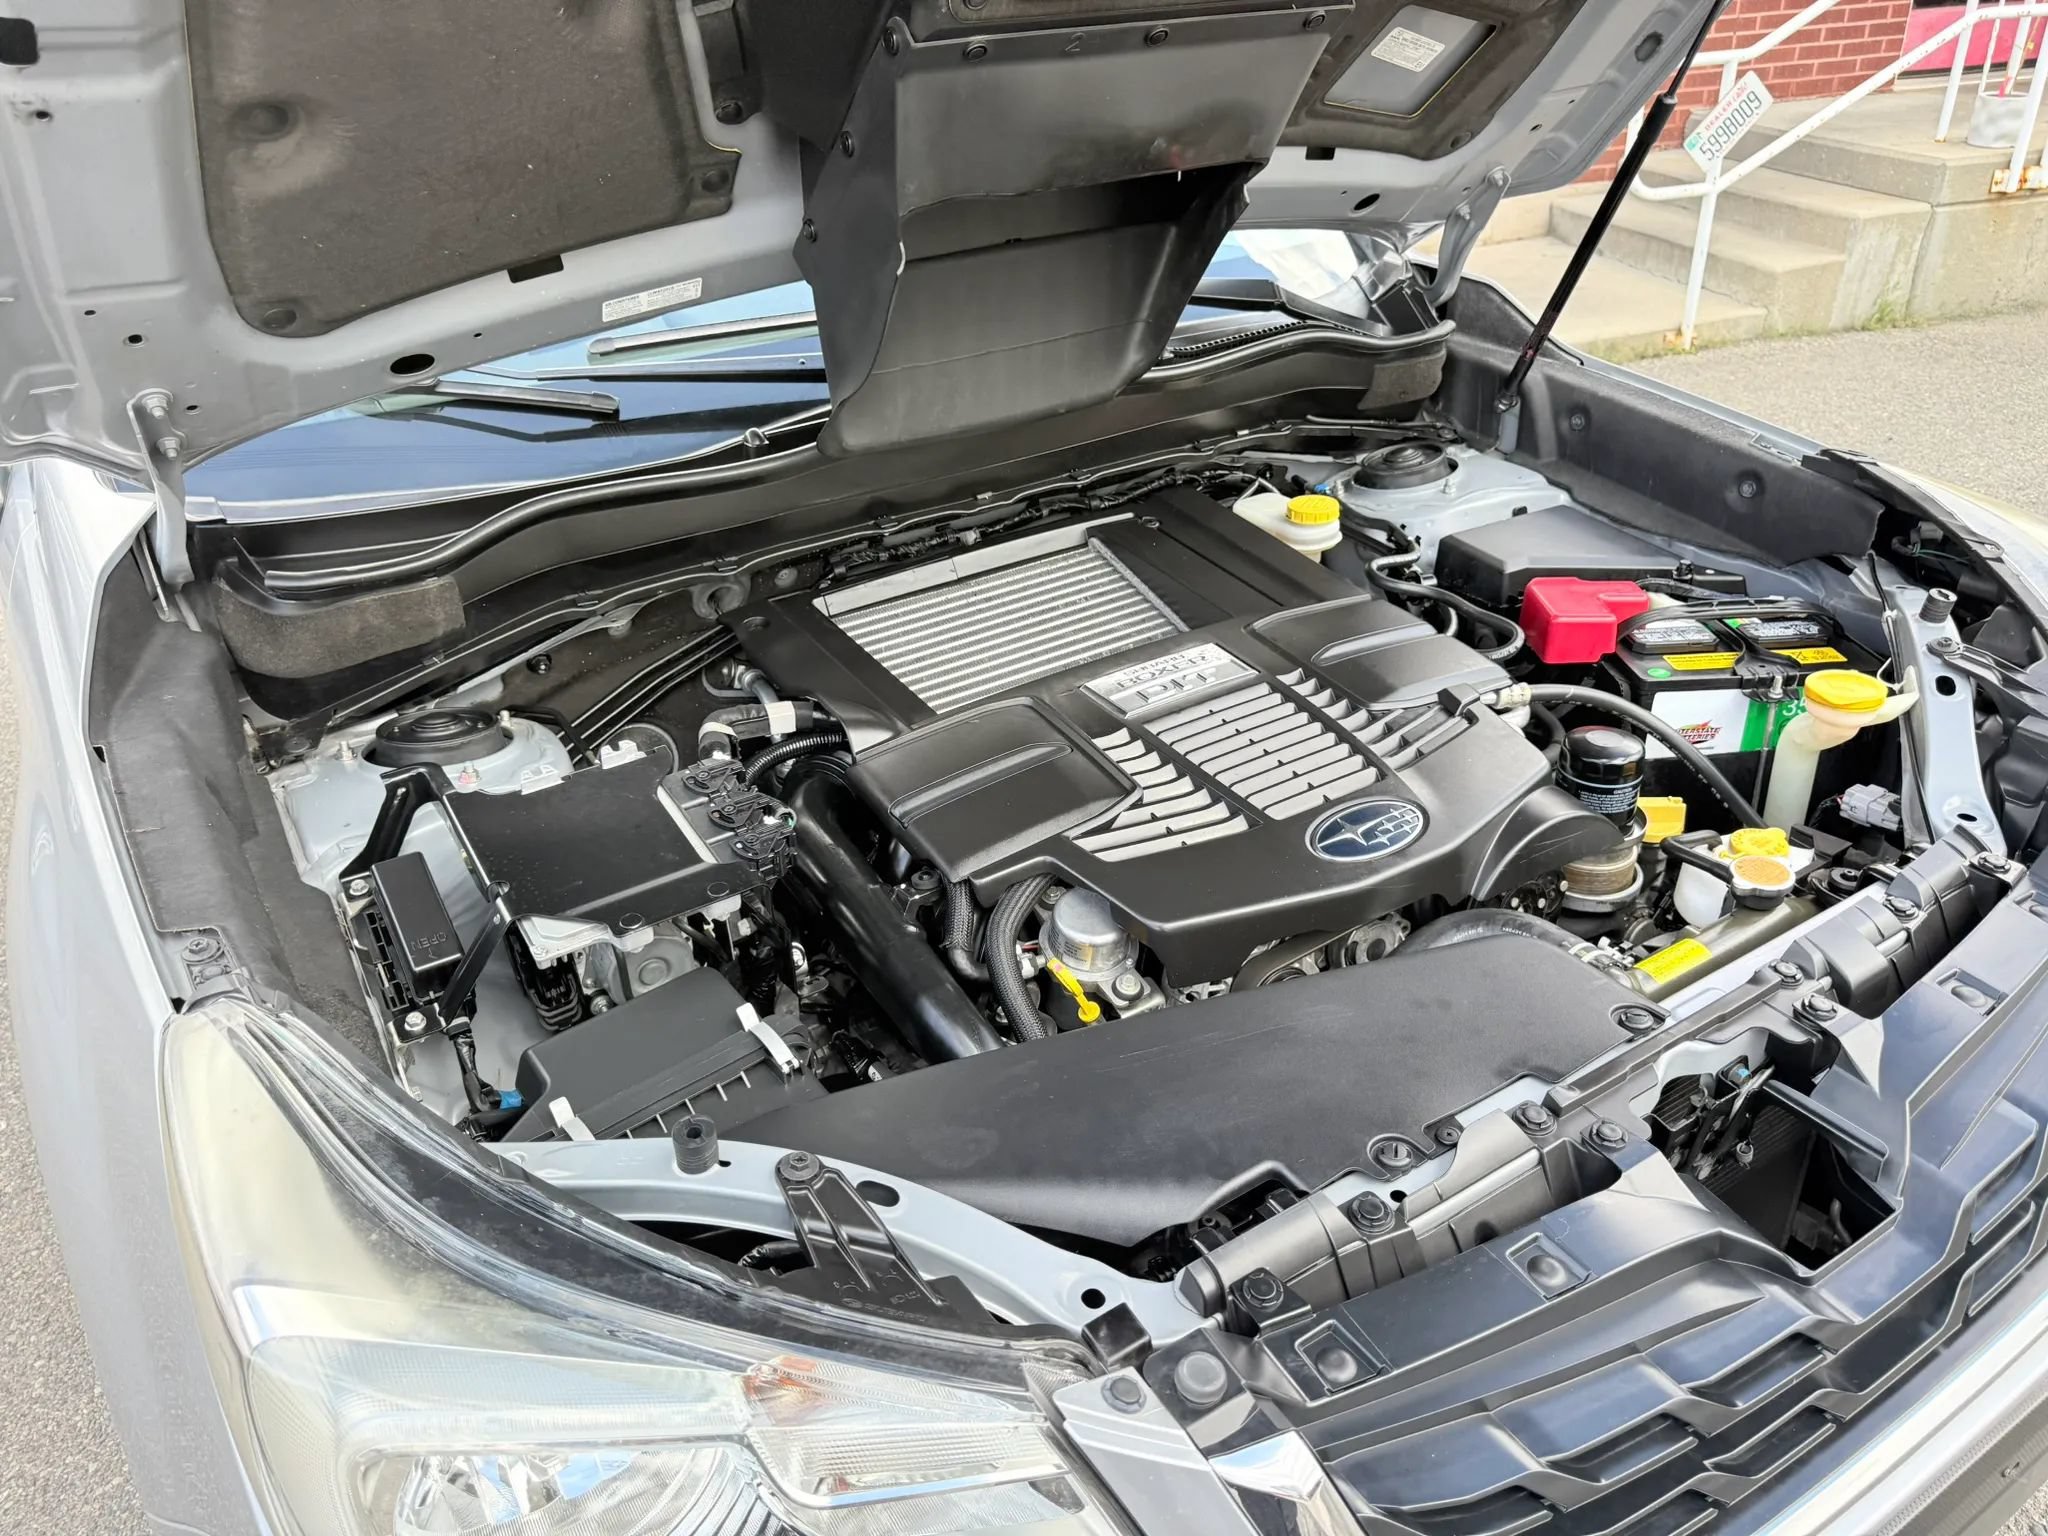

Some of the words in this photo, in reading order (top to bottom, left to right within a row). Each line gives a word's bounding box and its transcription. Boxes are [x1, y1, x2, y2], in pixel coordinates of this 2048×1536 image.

[1116, 654, 1211, 689] BOXER
[1676, 726, 1722, 735] TERSTATE
[1682, 733, 1716, 741] TTERIES
